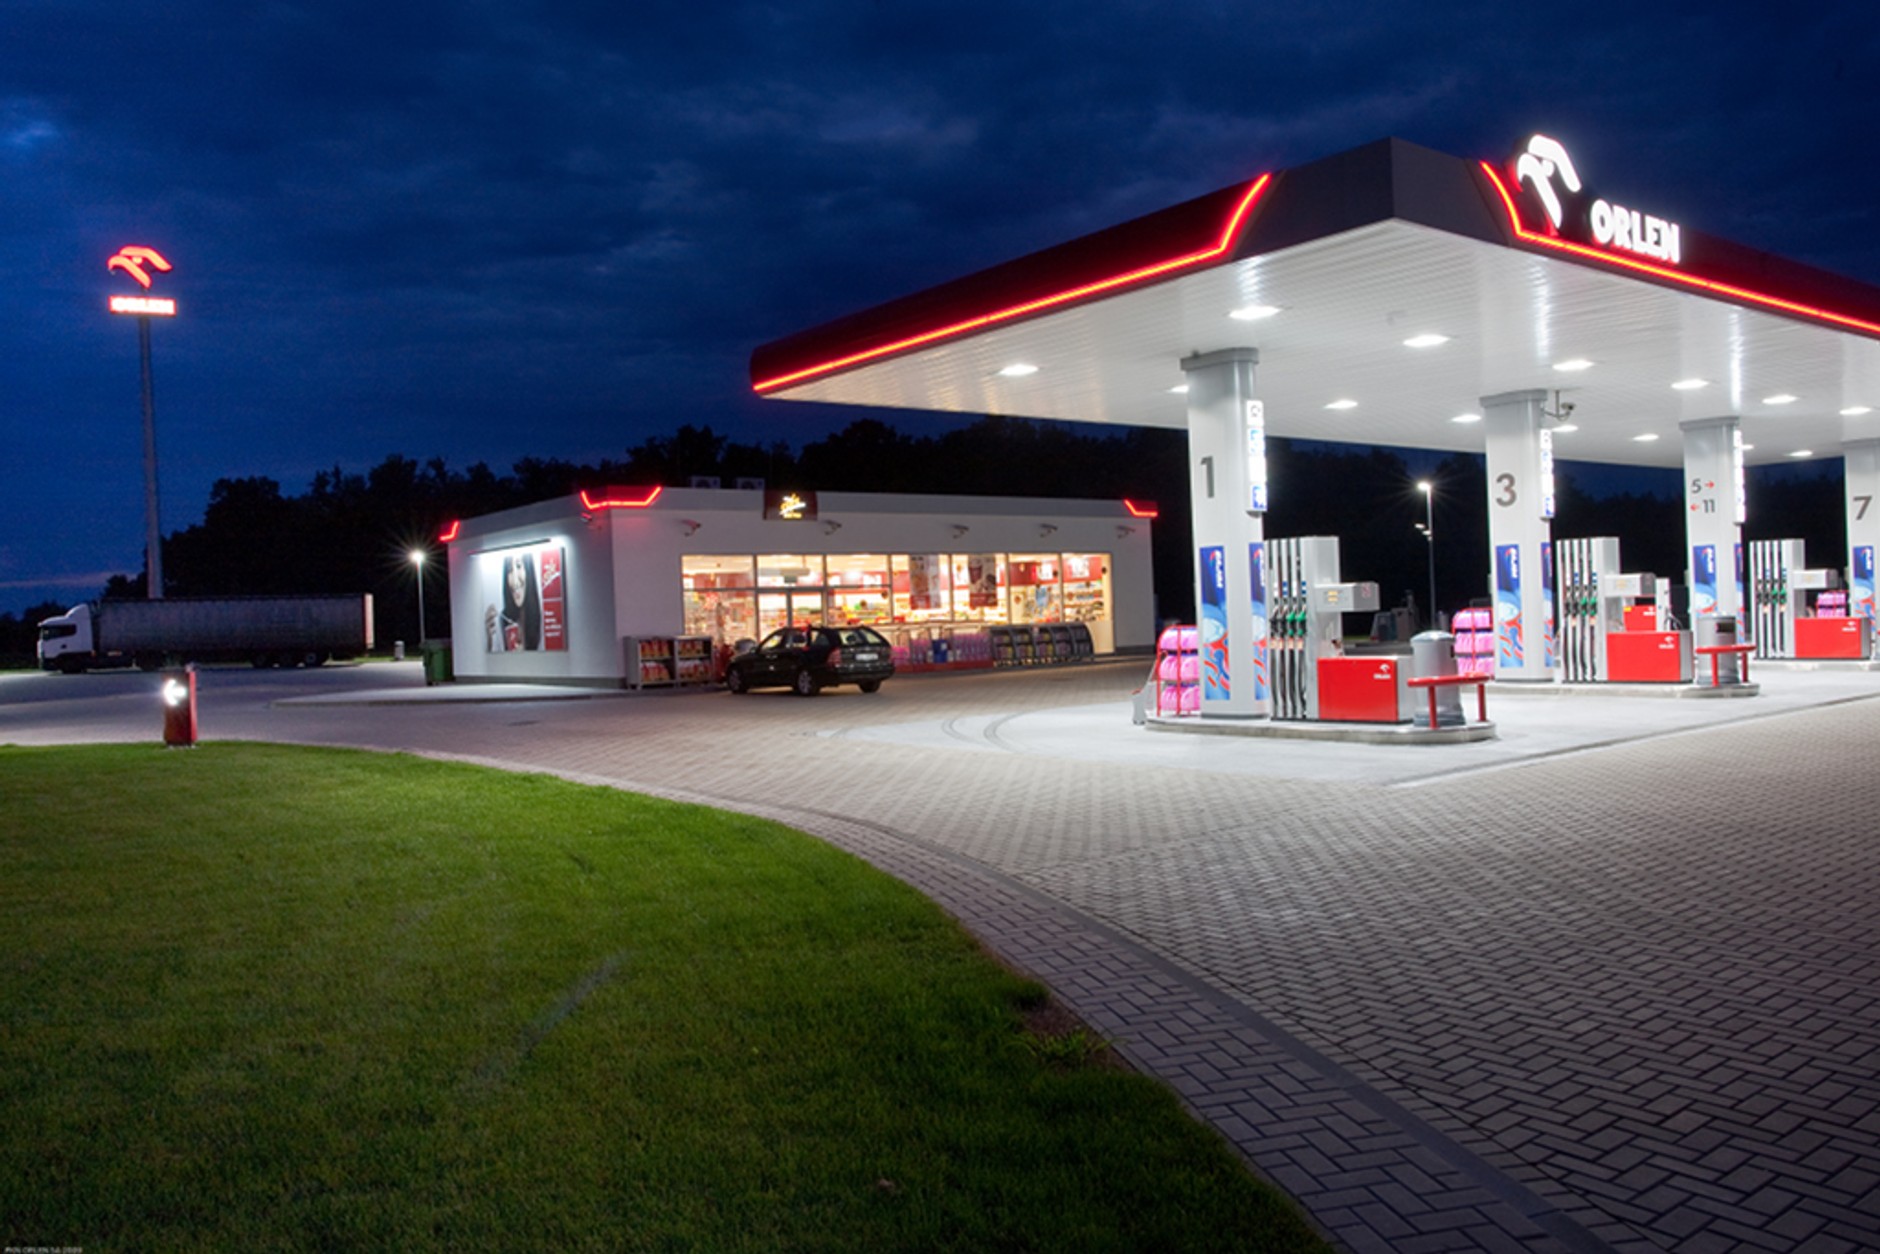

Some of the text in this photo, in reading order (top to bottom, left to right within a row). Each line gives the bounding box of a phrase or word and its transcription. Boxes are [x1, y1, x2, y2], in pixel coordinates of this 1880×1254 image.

[1591, 199, 1680, 263] ORLEN
[1200, 456, 1214, 498] 1
[1496, 473, 1517, 507] 3
[1691, 479, 1701, 493] 5
[1703, 499, 1716, 513] 11
[1854, 495, 1872, 521] 7
